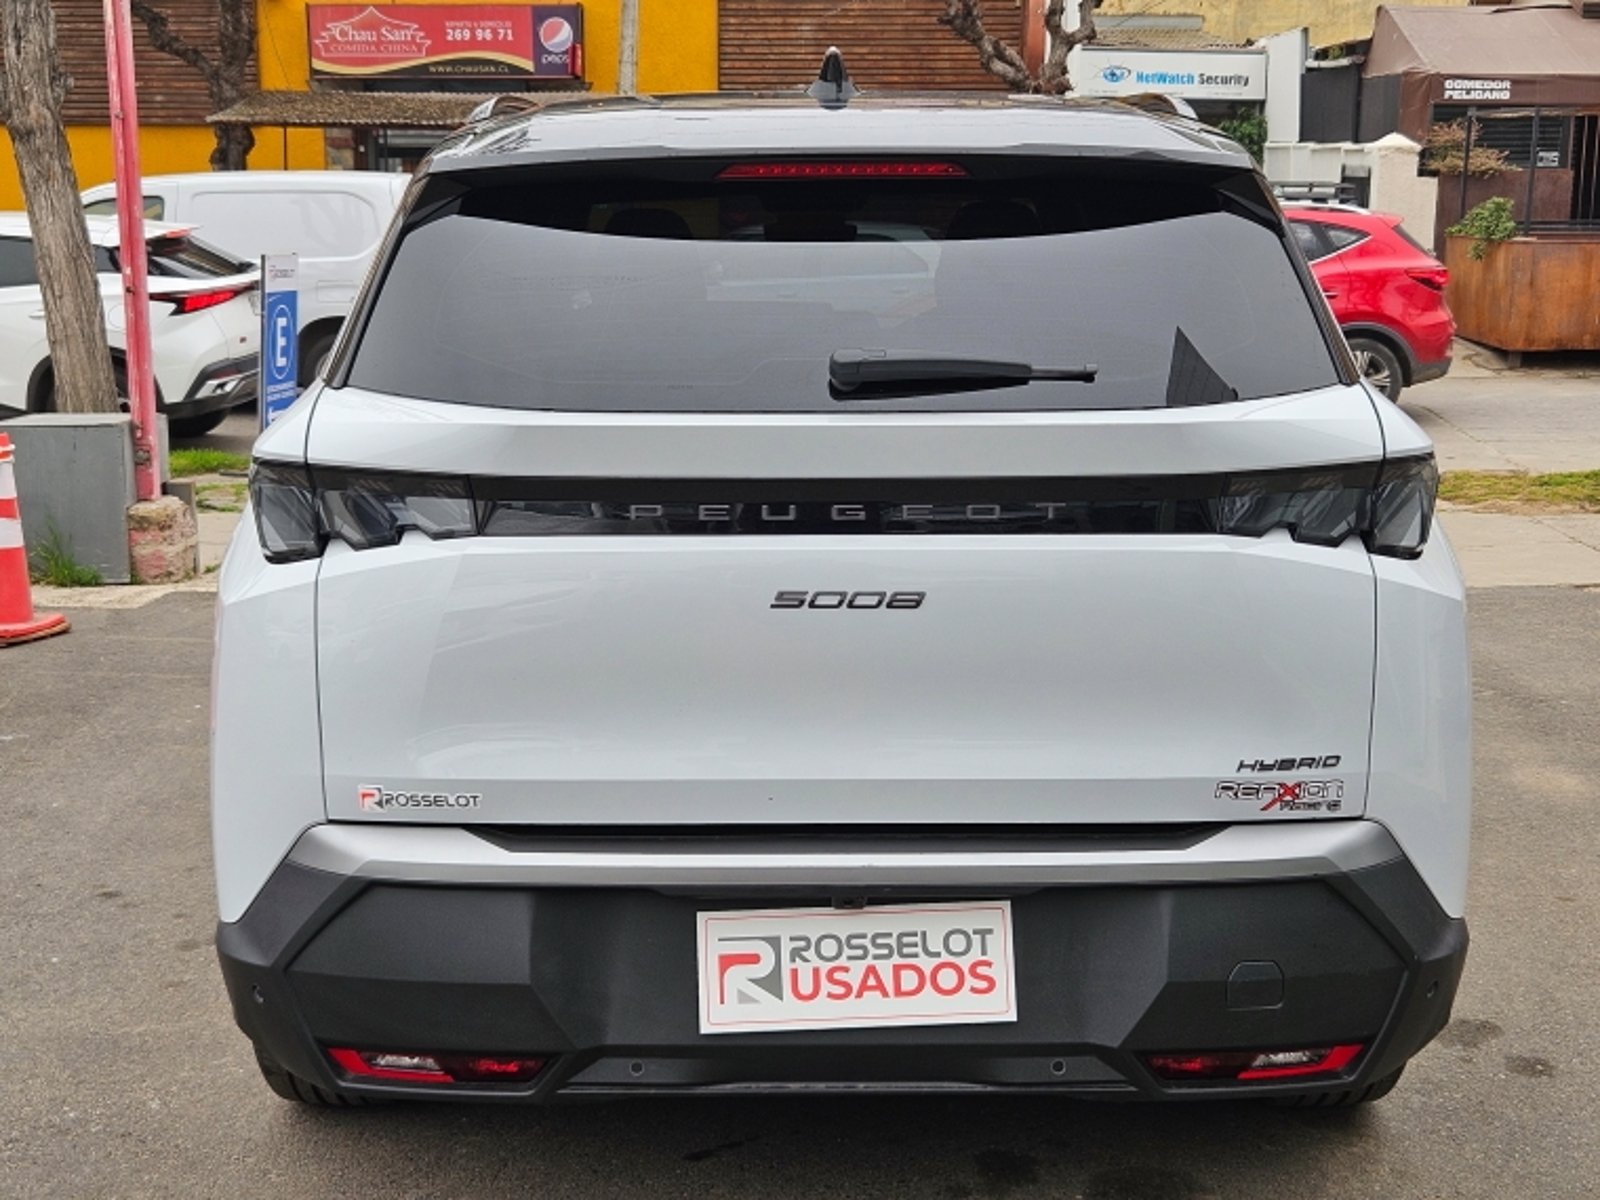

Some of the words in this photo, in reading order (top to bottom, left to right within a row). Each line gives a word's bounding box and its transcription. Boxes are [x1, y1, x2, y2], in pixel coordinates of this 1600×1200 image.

[335, 27, 377, 42] Chau
[380, 27, 411, 42] San
[446, 29, 470, 40] 269
[475, 29, 493, 40] 96
[498, 29, 513, 40] 71
[331, 44, 376, 53] COMIDA
[380, 44, 418, 53] CHINA
[1136, 71, 1194, 84] NetWatch
[1198, 73, 1249, 87] Security
[276, 317, 288, 368] E
[629, 502, 1067, 521] PEUGEOT
[770, 591, 926, 609] 5008
[1236, 755, 1342, 772] HYBRID
[383, 792, 481, 808] ROSSELOT
[788, 928, 994, 963] ROSSELOT
[789, 959, 997, 1002] USADOS
